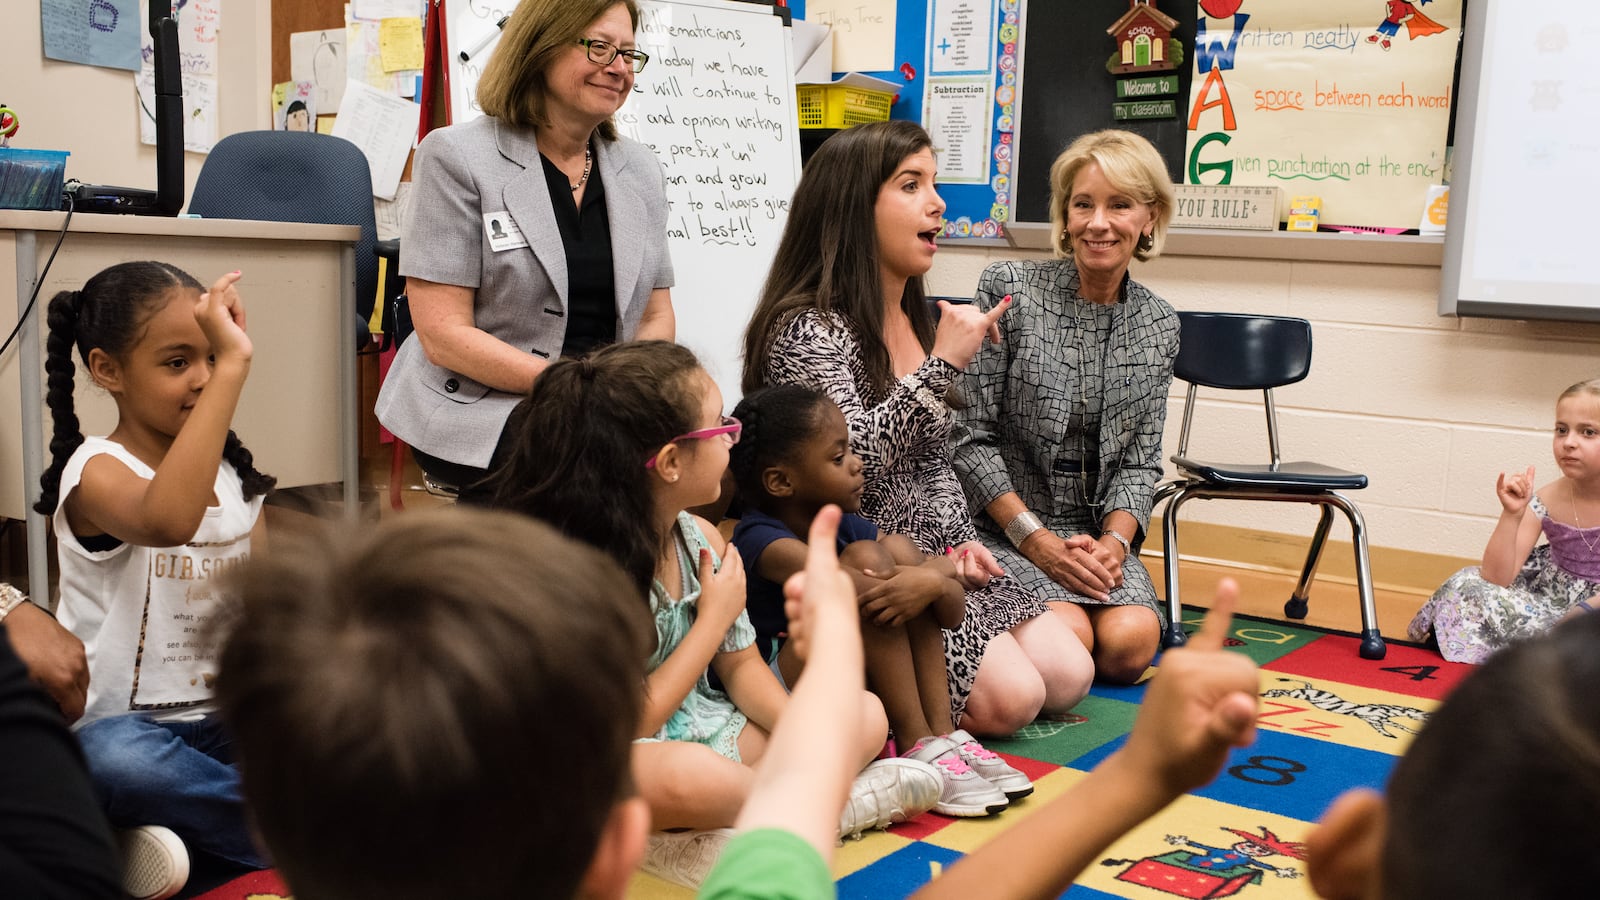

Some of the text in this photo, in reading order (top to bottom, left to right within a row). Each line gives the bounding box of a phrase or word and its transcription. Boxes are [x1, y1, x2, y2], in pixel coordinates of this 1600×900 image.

[637, 8, 746, 48] athematicians,
[1127, 26, 1156, 38] SCHOOL
[1304, 23, 1361, 54] neatly
[650, 44, 769, 78] Today we have
[692, 79, 759, 101] continue
[764, 84, 782, 106] to
[934, 85, 985, 94] Subtraction
[1124, 79, 1170, 96] Welcome to
[1187, 66, 1450, 131] A space between each word
[646, 104, 675, 125] and
[682, 112, 731, 138] opinion
[735, 107, 783, 142] writing
[1115, 103, 1173, 119] my classroom
[670, 139, 721, 164] prefix
[1267, 152, 1351, 177] punctuation
[1355, 156, 1372, 176] at
[1379, 153, 1403, 177] the
[695, 165, 723, 185] and
[730, 172, 768, 191] grow
[687, 191, 705, 212] to
[1177, 198, 1251, 219] YOU RULE
[173, 613, 194, 621] what
[162, 656, 176, 664] you
[1379, 665, 1441, 681] 4
[1227, 755, 1307, 786] 8
